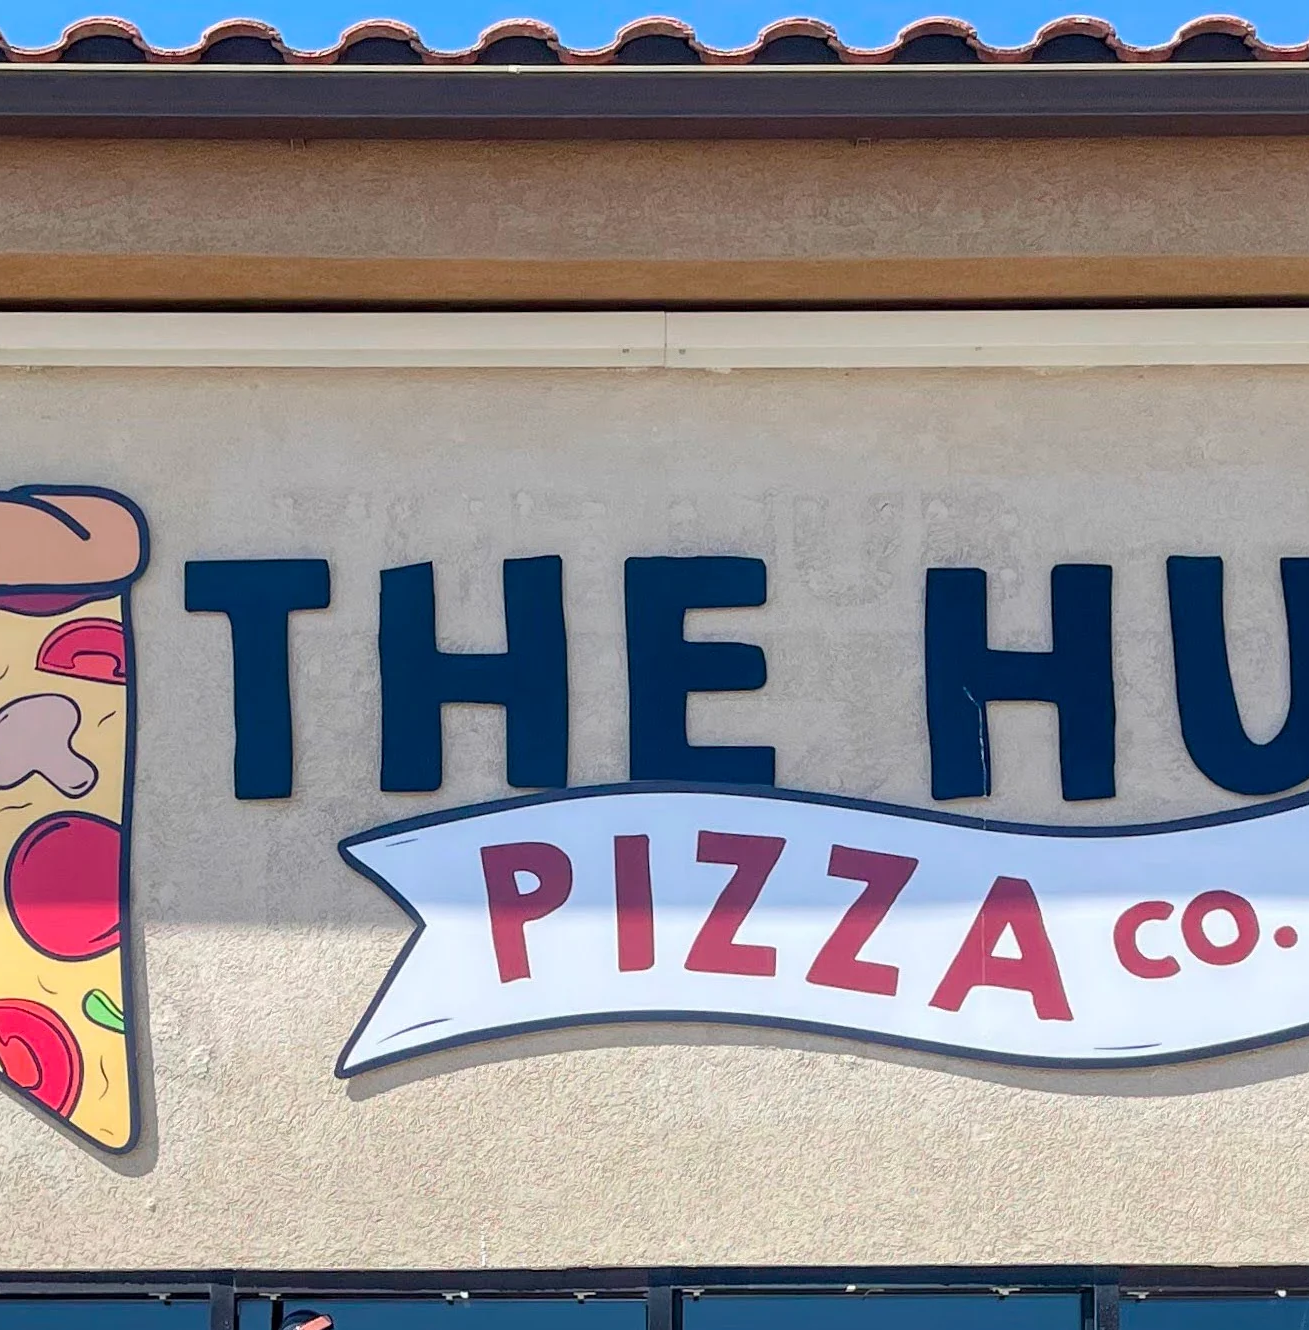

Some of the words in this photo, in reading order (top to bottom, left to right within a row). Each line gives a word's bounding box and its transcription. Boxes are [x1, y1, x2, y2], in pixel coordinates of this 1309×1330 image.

[184, 555, 777, 800] THE
[480, 829, 1074, 1022] PIZZA
[1113, 890, 1299, 980] CO.
